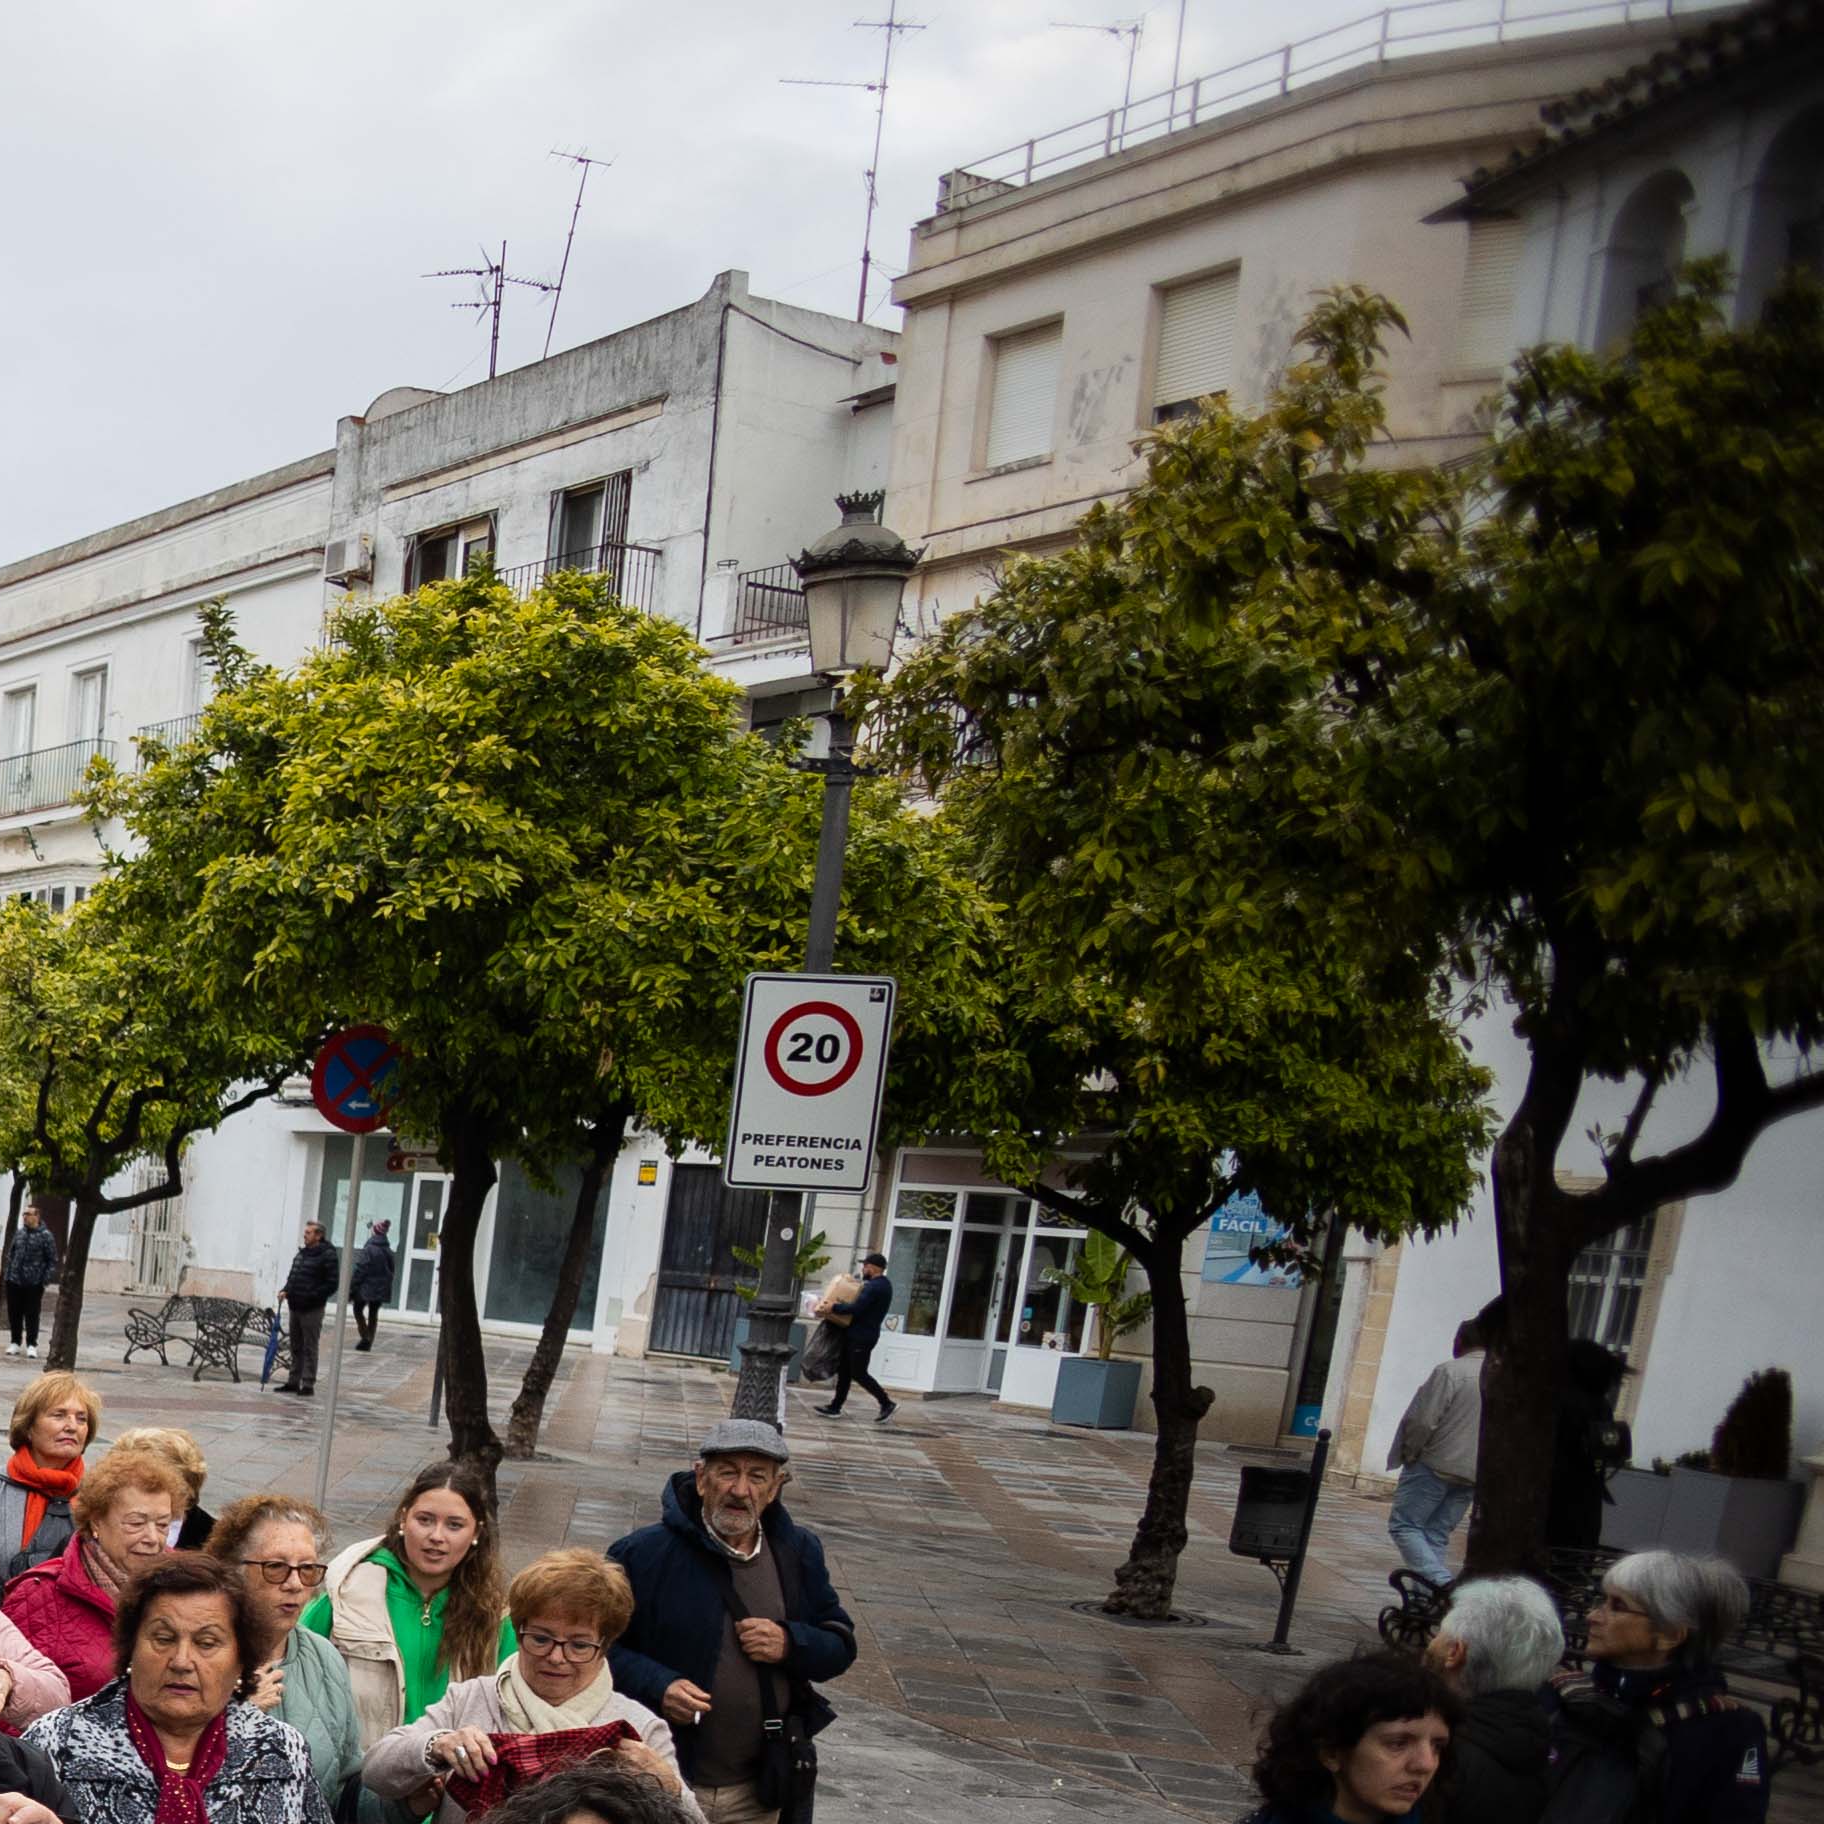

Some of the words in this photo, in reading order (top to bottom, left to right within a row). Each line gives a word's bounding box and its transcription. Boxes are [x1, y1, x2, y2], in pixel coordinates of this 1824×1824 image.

[787, 1033, 840, 1063] 20
[741, 1132, 863, 1152] PREFERENCIA
[753, 1154, 845, 1171] PEATONES
